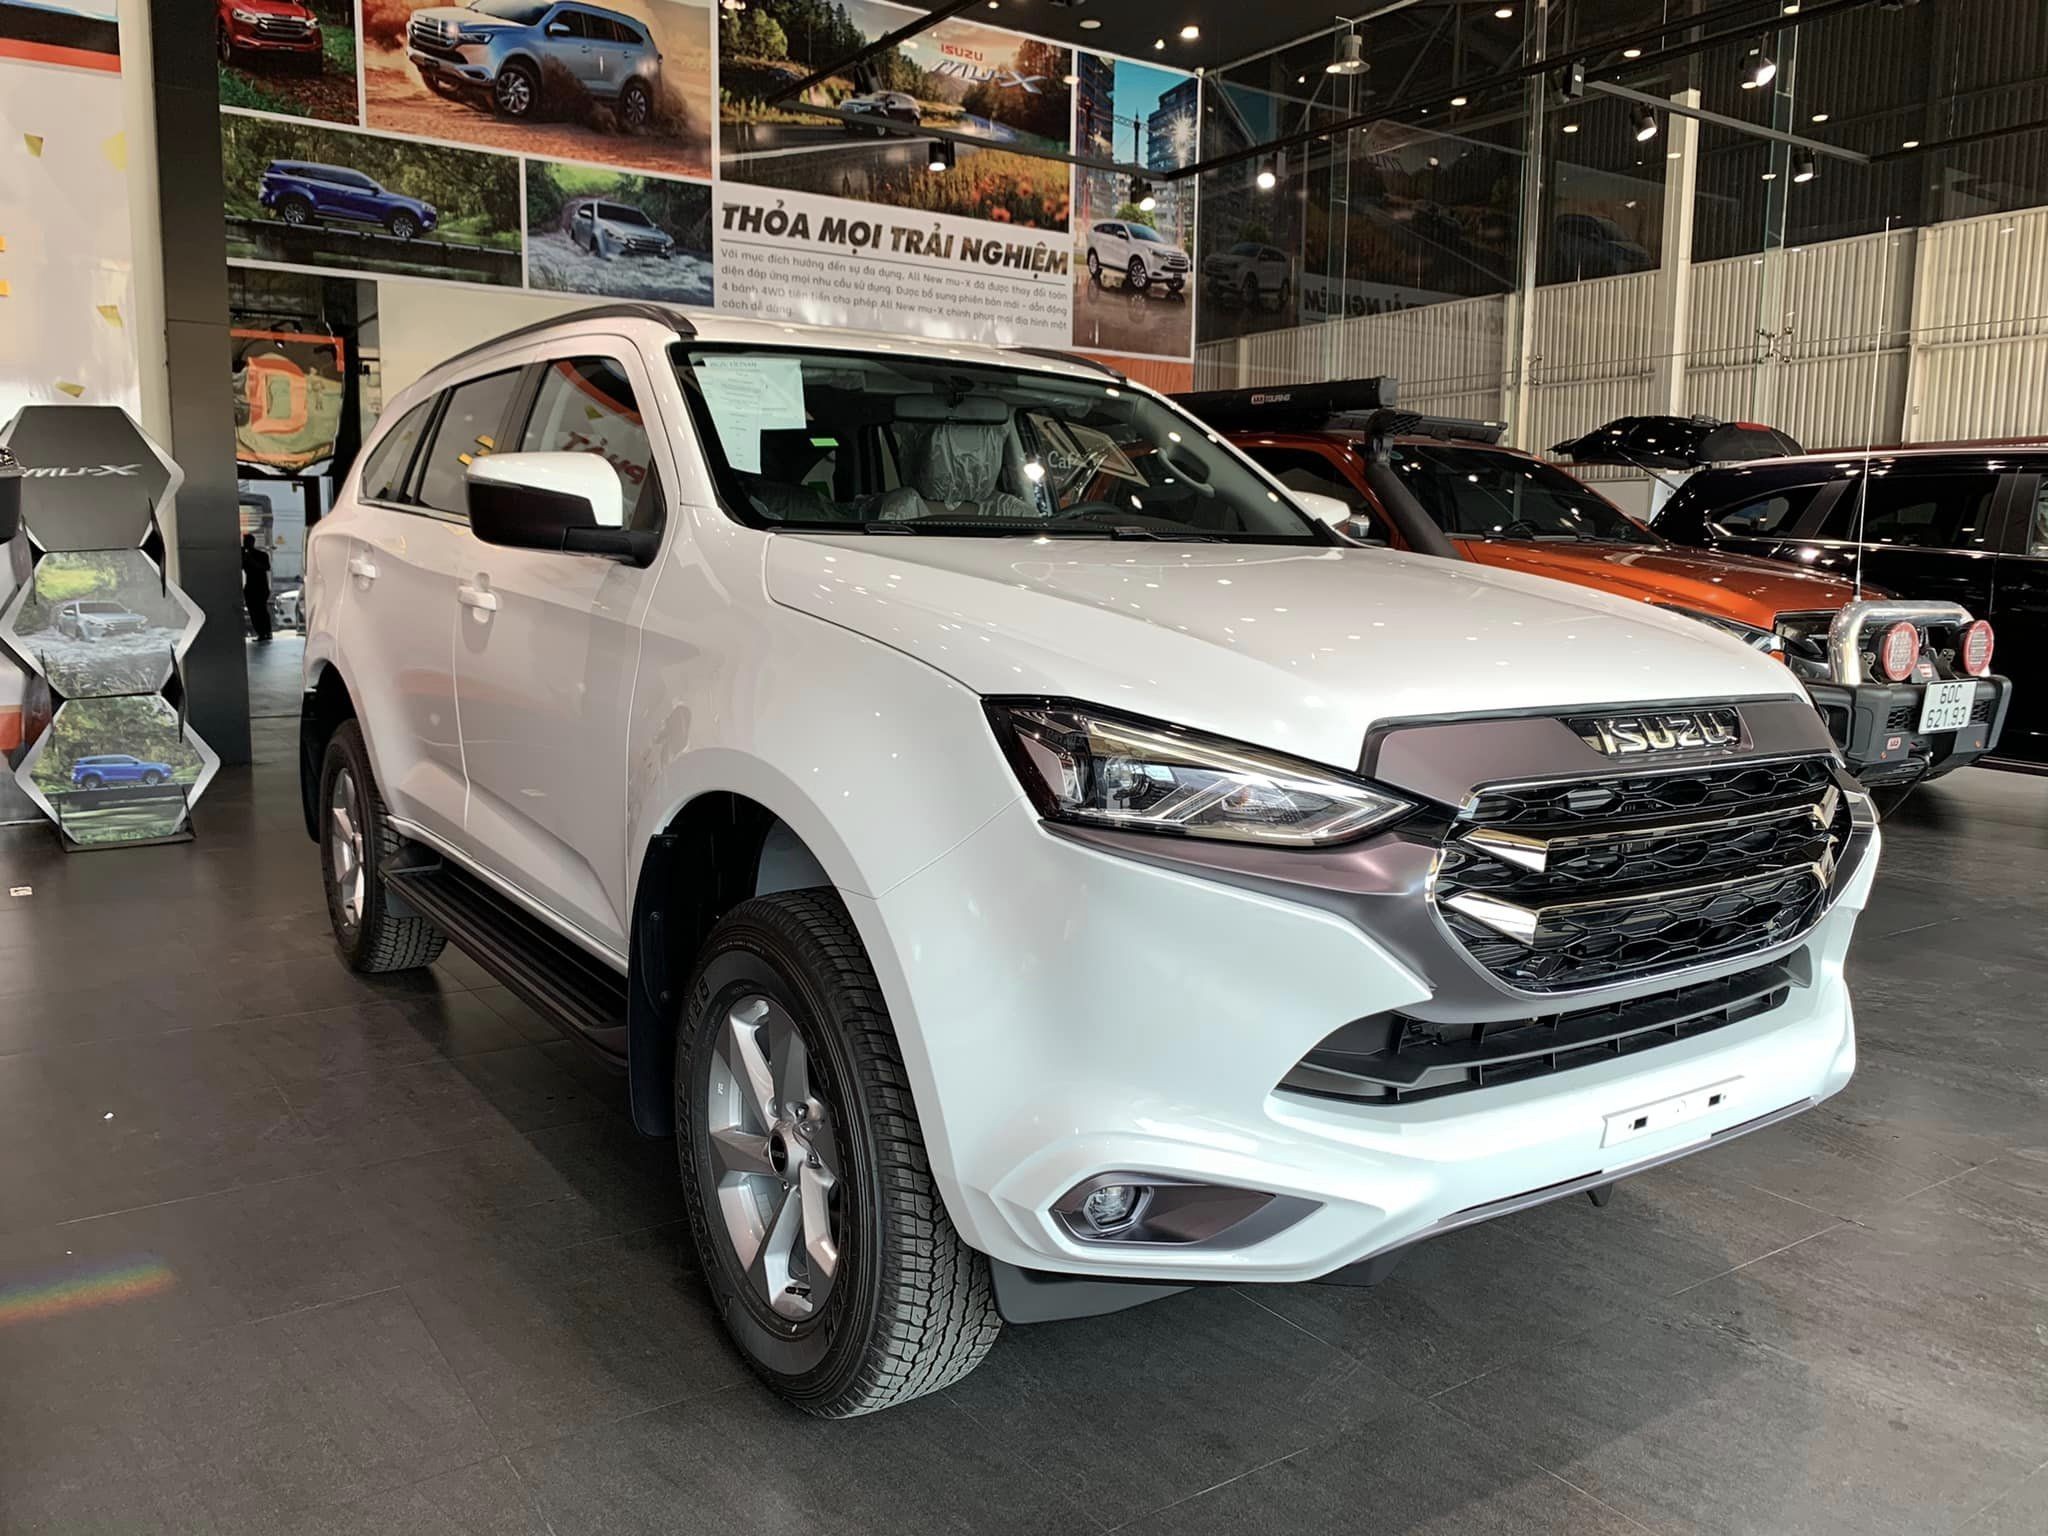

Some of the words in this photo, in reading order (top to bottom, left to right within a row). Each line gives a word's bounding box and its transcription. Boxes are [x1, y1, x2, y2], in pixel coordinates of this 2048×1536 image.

[941, 43, 984, 61] ISUZU
[721, 199, 810, 240] THỎA
[818, 216, 883, 254] MỌI
[890, 222, 954, 259] TRẢI
[960, 236, 1069, 279] NGHIỆM
[721, 282, 729, 291] 4
[1939, 684, 1963, 705] 60C
[1926, 706, 1967, 729] 621.93
[1593, 711, 1731, 755] ISUZU
